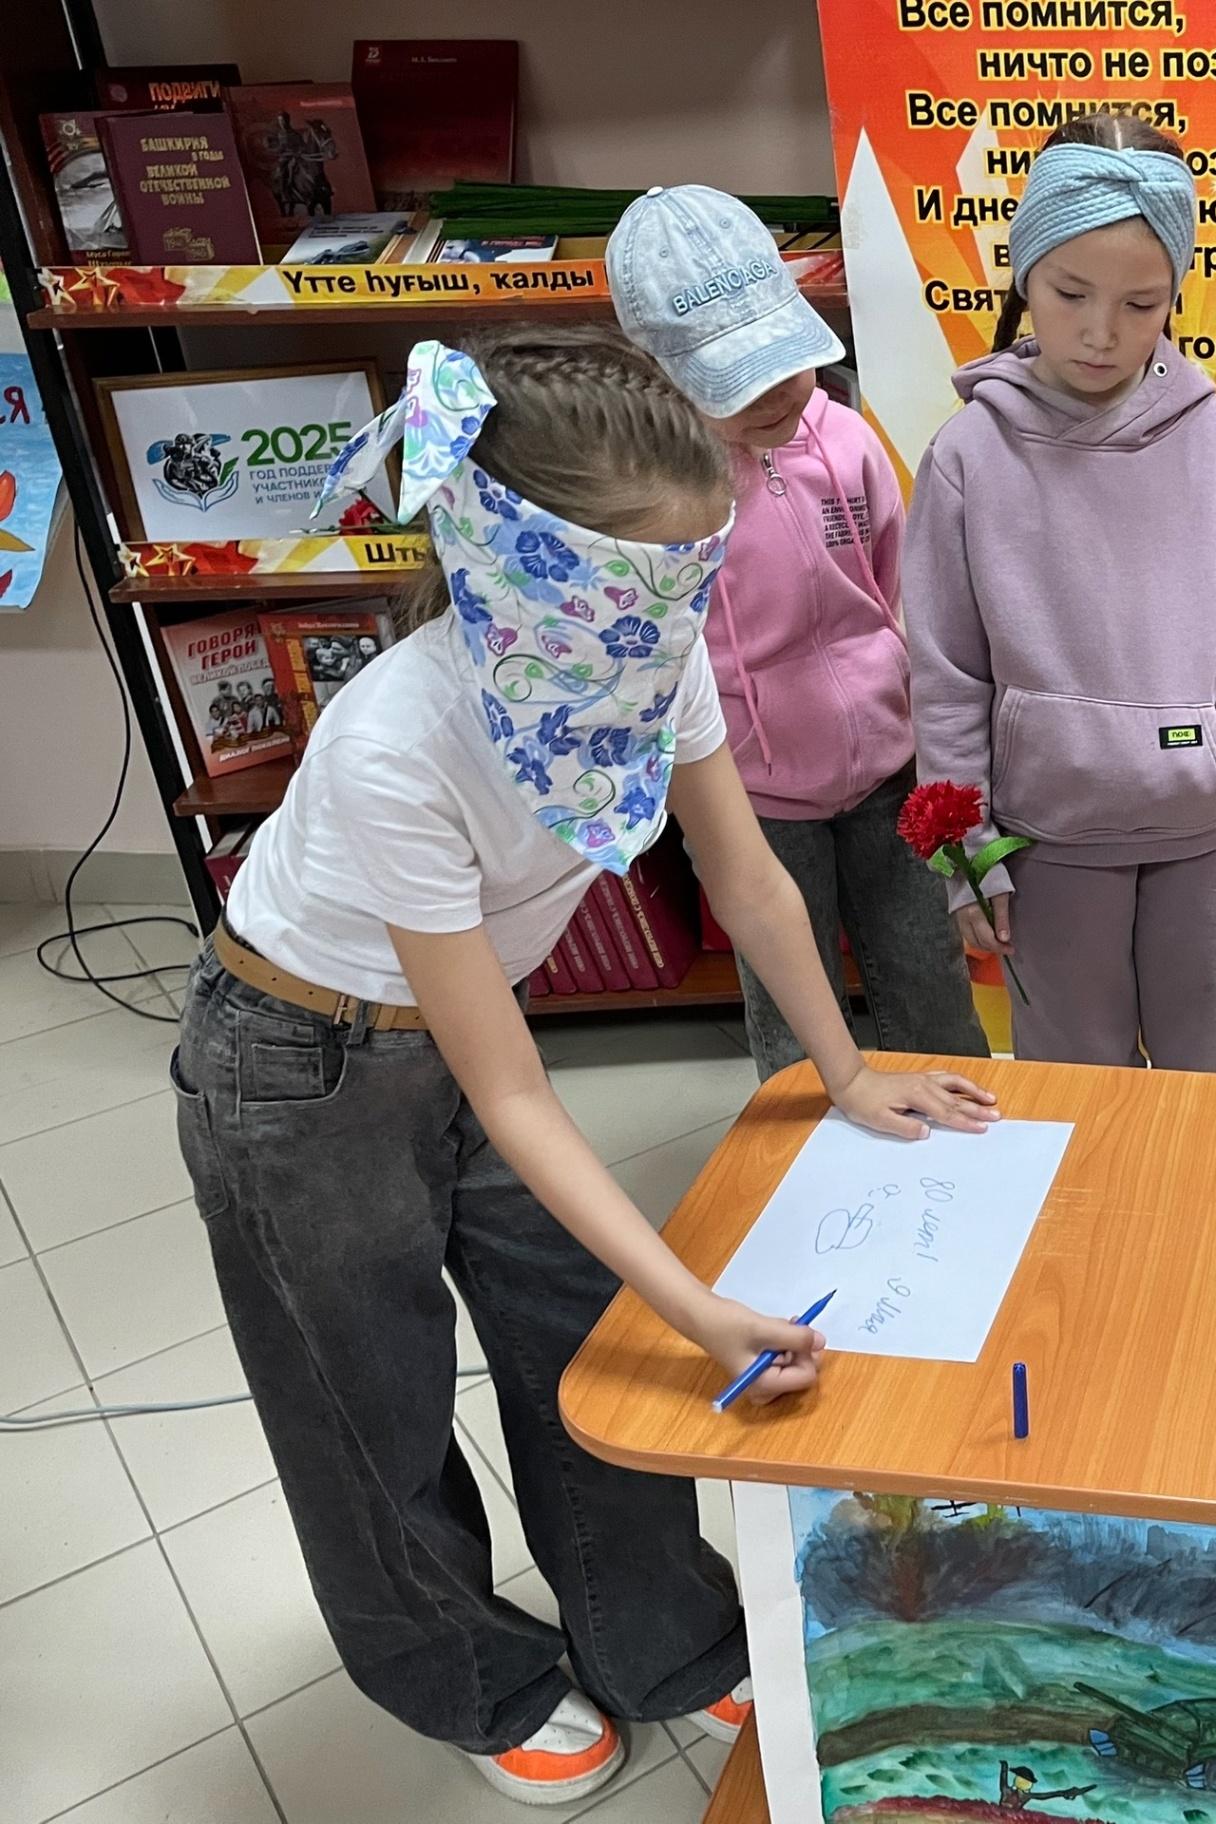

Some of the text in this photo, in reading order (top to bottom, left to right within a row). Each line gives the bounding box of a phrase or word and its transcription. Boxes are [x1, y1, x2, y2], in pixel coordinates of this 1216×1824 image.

[899, 0, 1184, 33] Все помнится,
[979, 51, 1093, 78] ничто
[1104, 51, 1150, 78] не
[908, 92, 977, 126] Все
[139, 136, 209, 152] БАШКИРИЯ
[139, 175, 232, 193] ОТЕЧЕСТВЕННОЙ
[145, 162, 198, 178] ВЕЛИКОЙ
[916, 189, 1017, 226] И дне
[672, 258, 778, 316] BALENCIAGA
[924, 280, 1006, 313] Свят
[240, 420, 353, 467] 2025
[248, 463, 332, 481] ГОД ПОДДЕР
[266, 491, 312, 503] ЧЛЕНОВ
[200, 639, 257, 671] ГЕРОИ
[919, 1176, 956, 1203] 80
